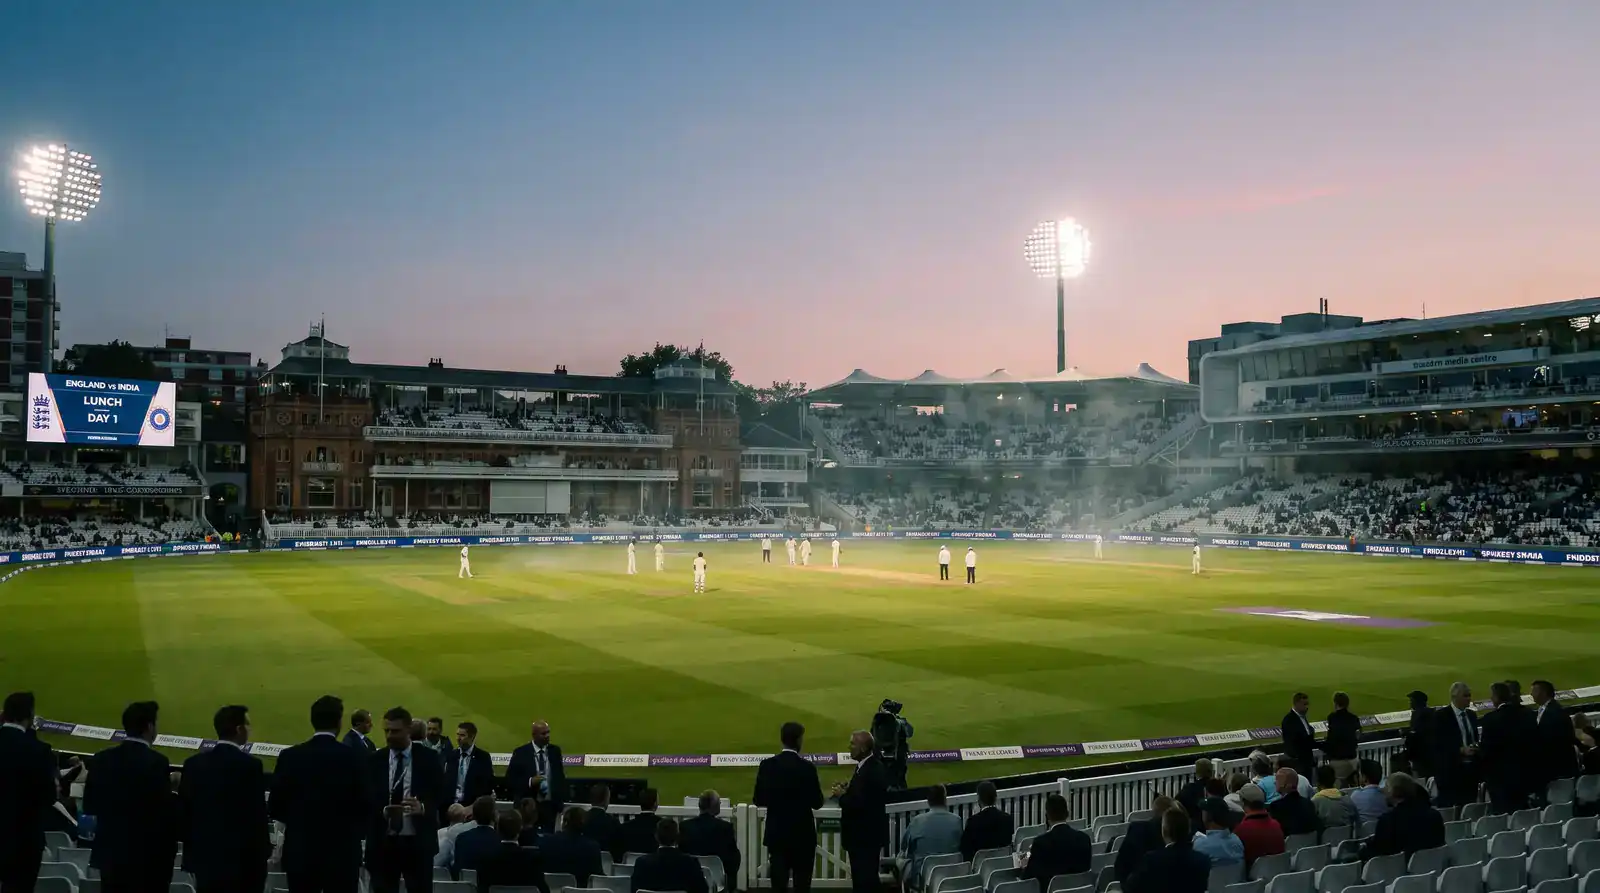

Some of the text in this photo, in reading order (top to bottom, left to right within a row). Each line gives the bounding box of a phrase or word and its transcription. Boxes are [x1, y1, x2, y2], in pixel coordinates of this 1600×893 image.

[65, 379, 106, 389] ENGLAND
[117, 383, 140, 392] INDIA
[83, 396, 123, 407] LUNCH
[87, 413, 118, 424] DAY 1
